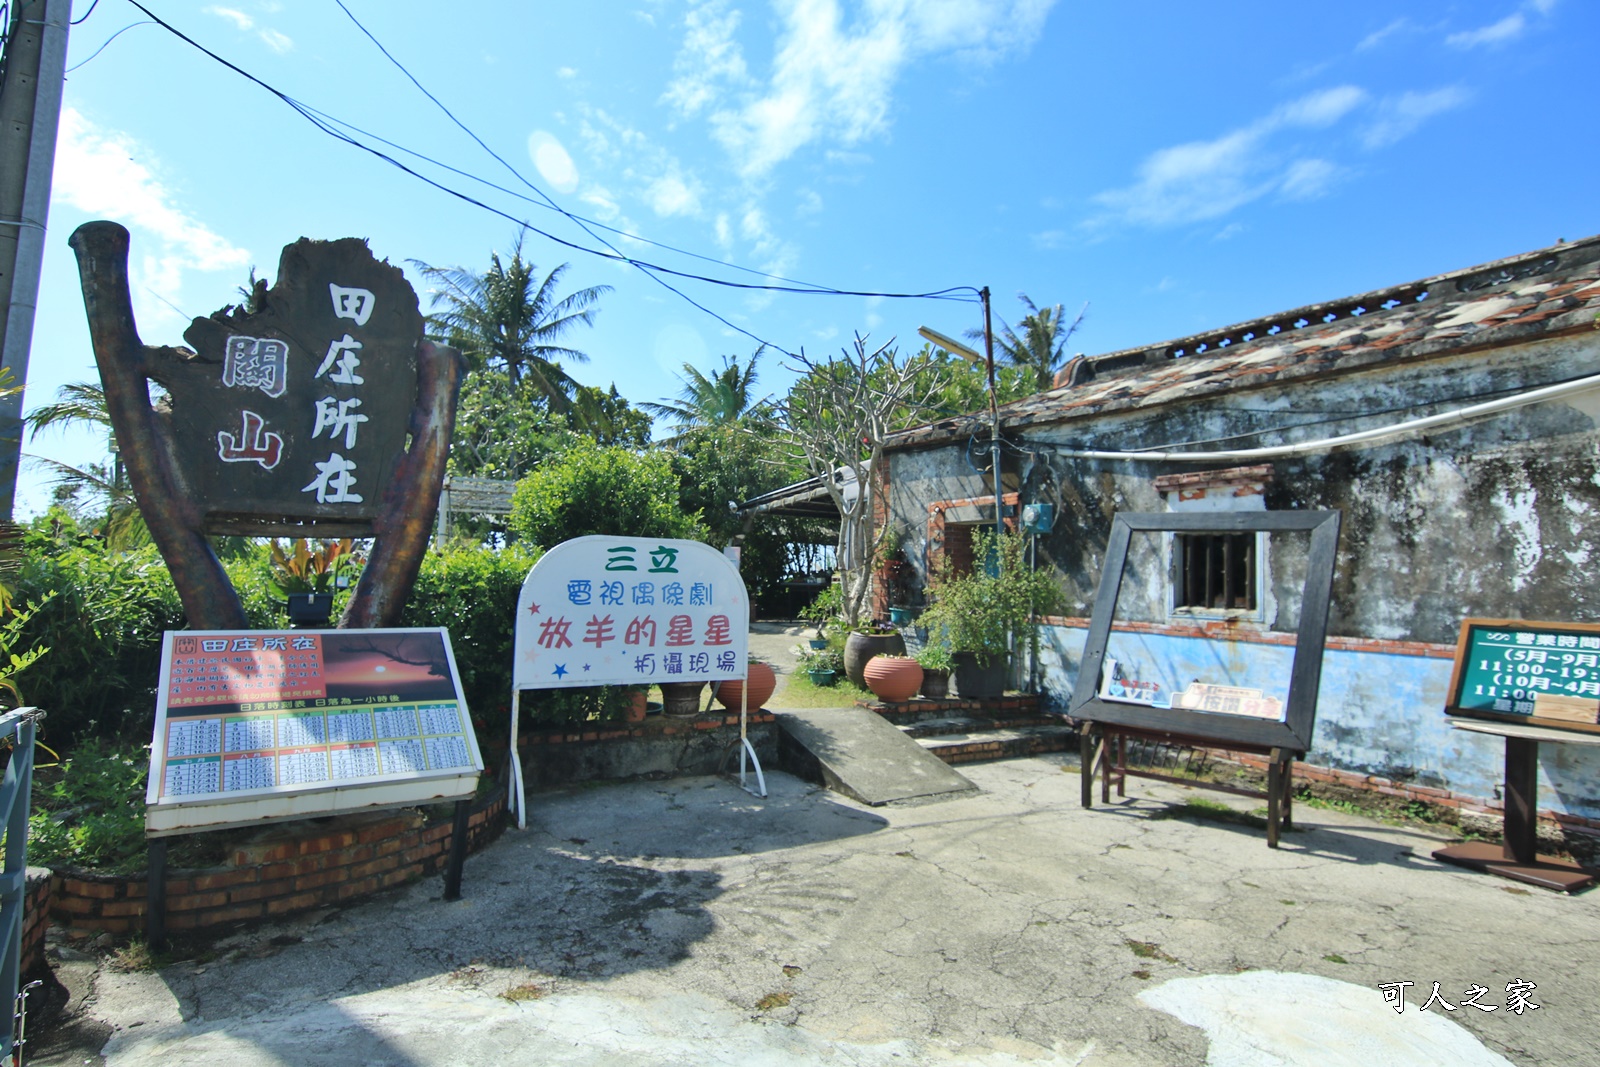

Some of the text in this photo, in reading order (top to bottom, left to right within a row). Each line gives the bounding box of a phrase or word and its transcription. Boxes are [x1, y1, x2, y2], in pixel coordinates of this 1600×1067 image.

[218, 335, 289, 470] 關山
[301, 282, 376, 504] 田庄所在
[604, 545, 680, 574] 三立
[567, 579, 713, 607] 電視偶像劇
[537, 613, 733, 649] 放羊的星星
[1515, 632, 1600, 650] 營業時間
[201, 635, 317, 653] 田庄所在
[1504, 648, 1600, 668] (5月~9月
[240, 699, 306, 712] 日落時刻表
[1492, 698, 1534, 715] 星期
